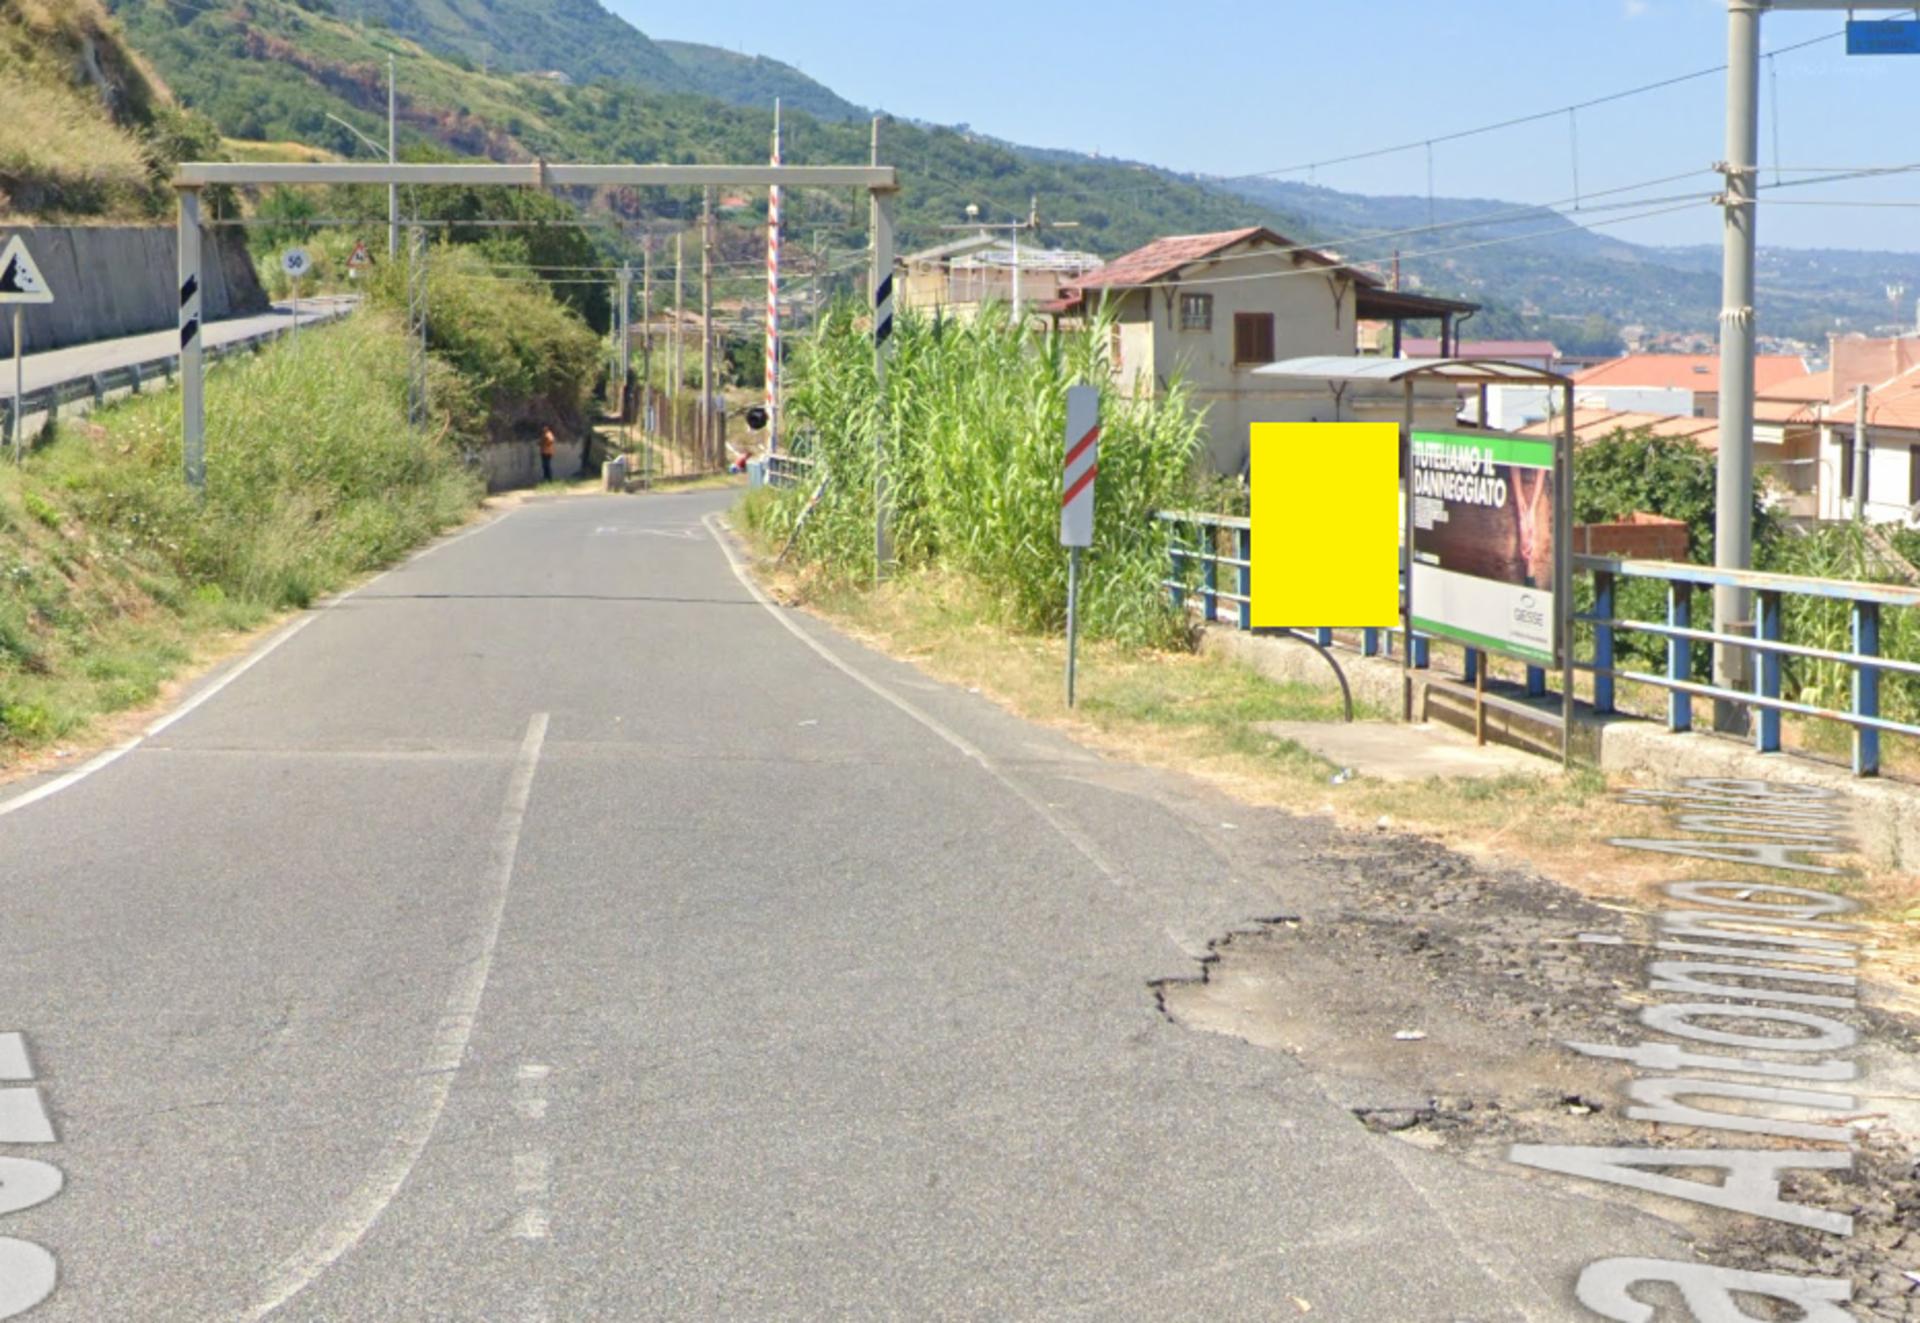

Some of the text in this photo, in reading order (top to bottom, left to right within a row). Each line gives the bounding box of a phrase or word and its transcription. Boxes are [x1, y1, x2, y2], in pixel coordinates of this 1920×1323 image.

[287, 255, 303, 269] 50
[1483, 448, 1496, 476] IL
[1414, 469, 1507, 508] DANNEGGIATO
